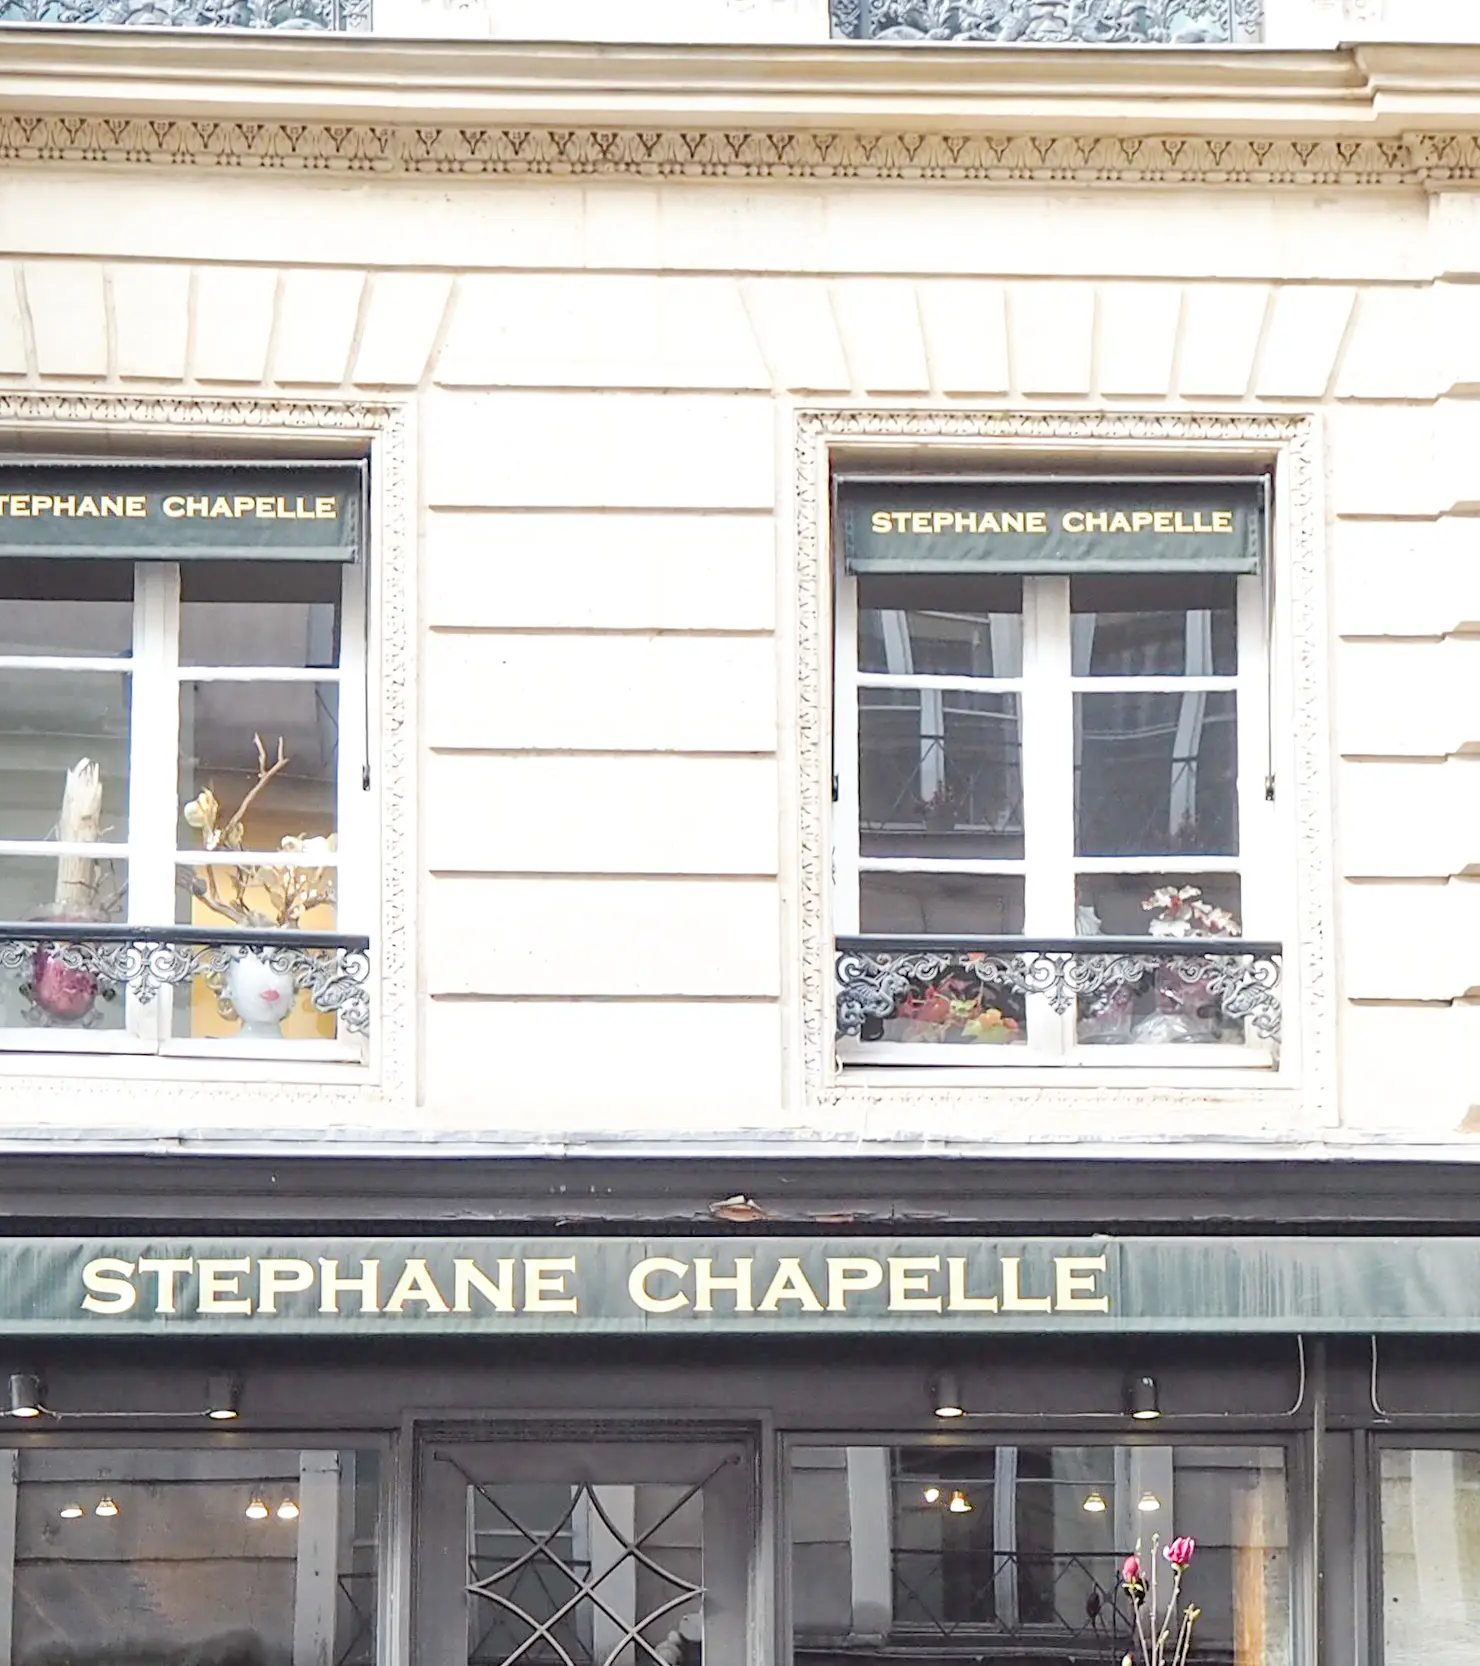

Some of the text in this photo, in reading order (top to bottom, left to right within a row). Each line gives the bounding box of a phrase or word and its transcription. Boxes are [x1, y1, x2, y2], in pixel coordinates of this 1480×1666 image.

[162, 496, 337, 520] CHAPELLE
[871, 510, 1237, 534] STEPHANE CHAPELLE
[79, 1254, 1111, 1316] STEPHANE CHAPELLE
